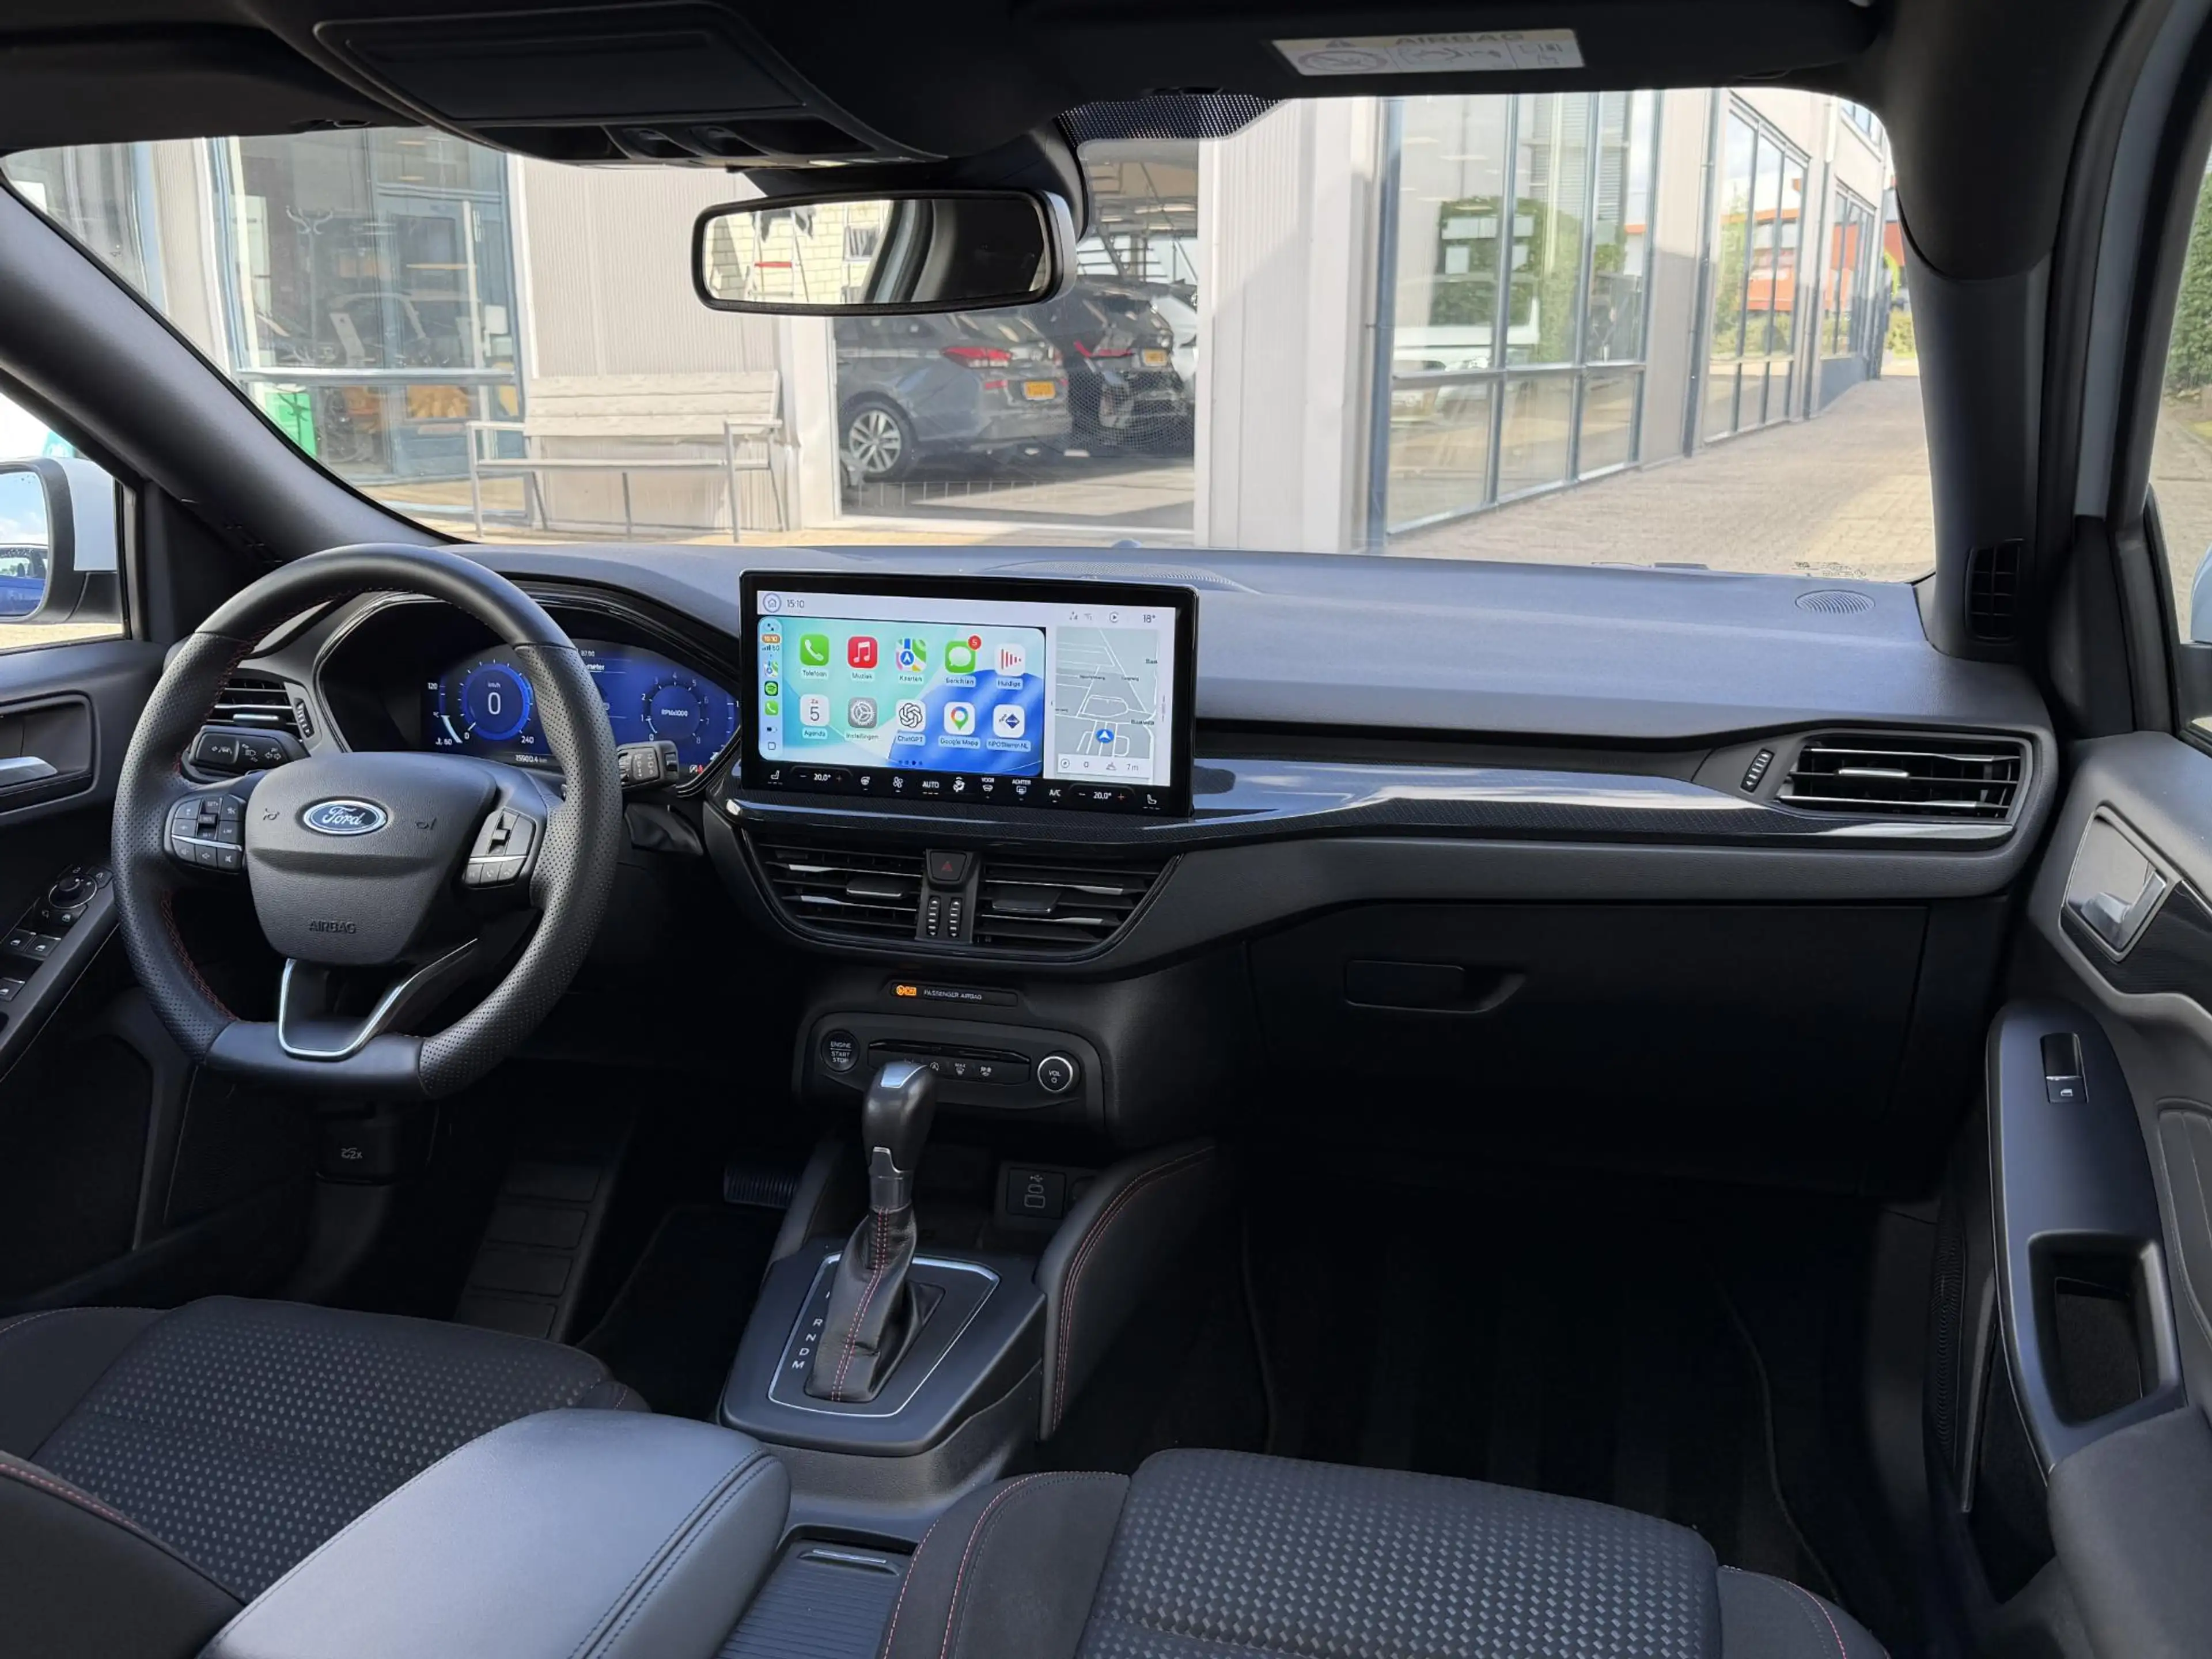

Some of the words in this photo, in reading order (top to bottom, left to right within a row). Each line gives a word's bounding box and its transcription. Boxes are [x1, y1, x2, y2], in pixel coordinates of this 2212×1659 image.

[787, 599, 804, 608] 15:10
[428, 682, 438, 690] 120
[488, 692, 501, 715] 0
[810, 706, 820, 721] 5
[521, 736, 534, 744] 240
[322, 806, 365, 825] Ford
[309, 921, 356, 934] AIRBAG
[924, 990, 959, 998] PASSENGER
[813, 1319, 823, 1327] R
[805, 1334, 816, 1342] N
[791, 1361, 805, 1369] M
